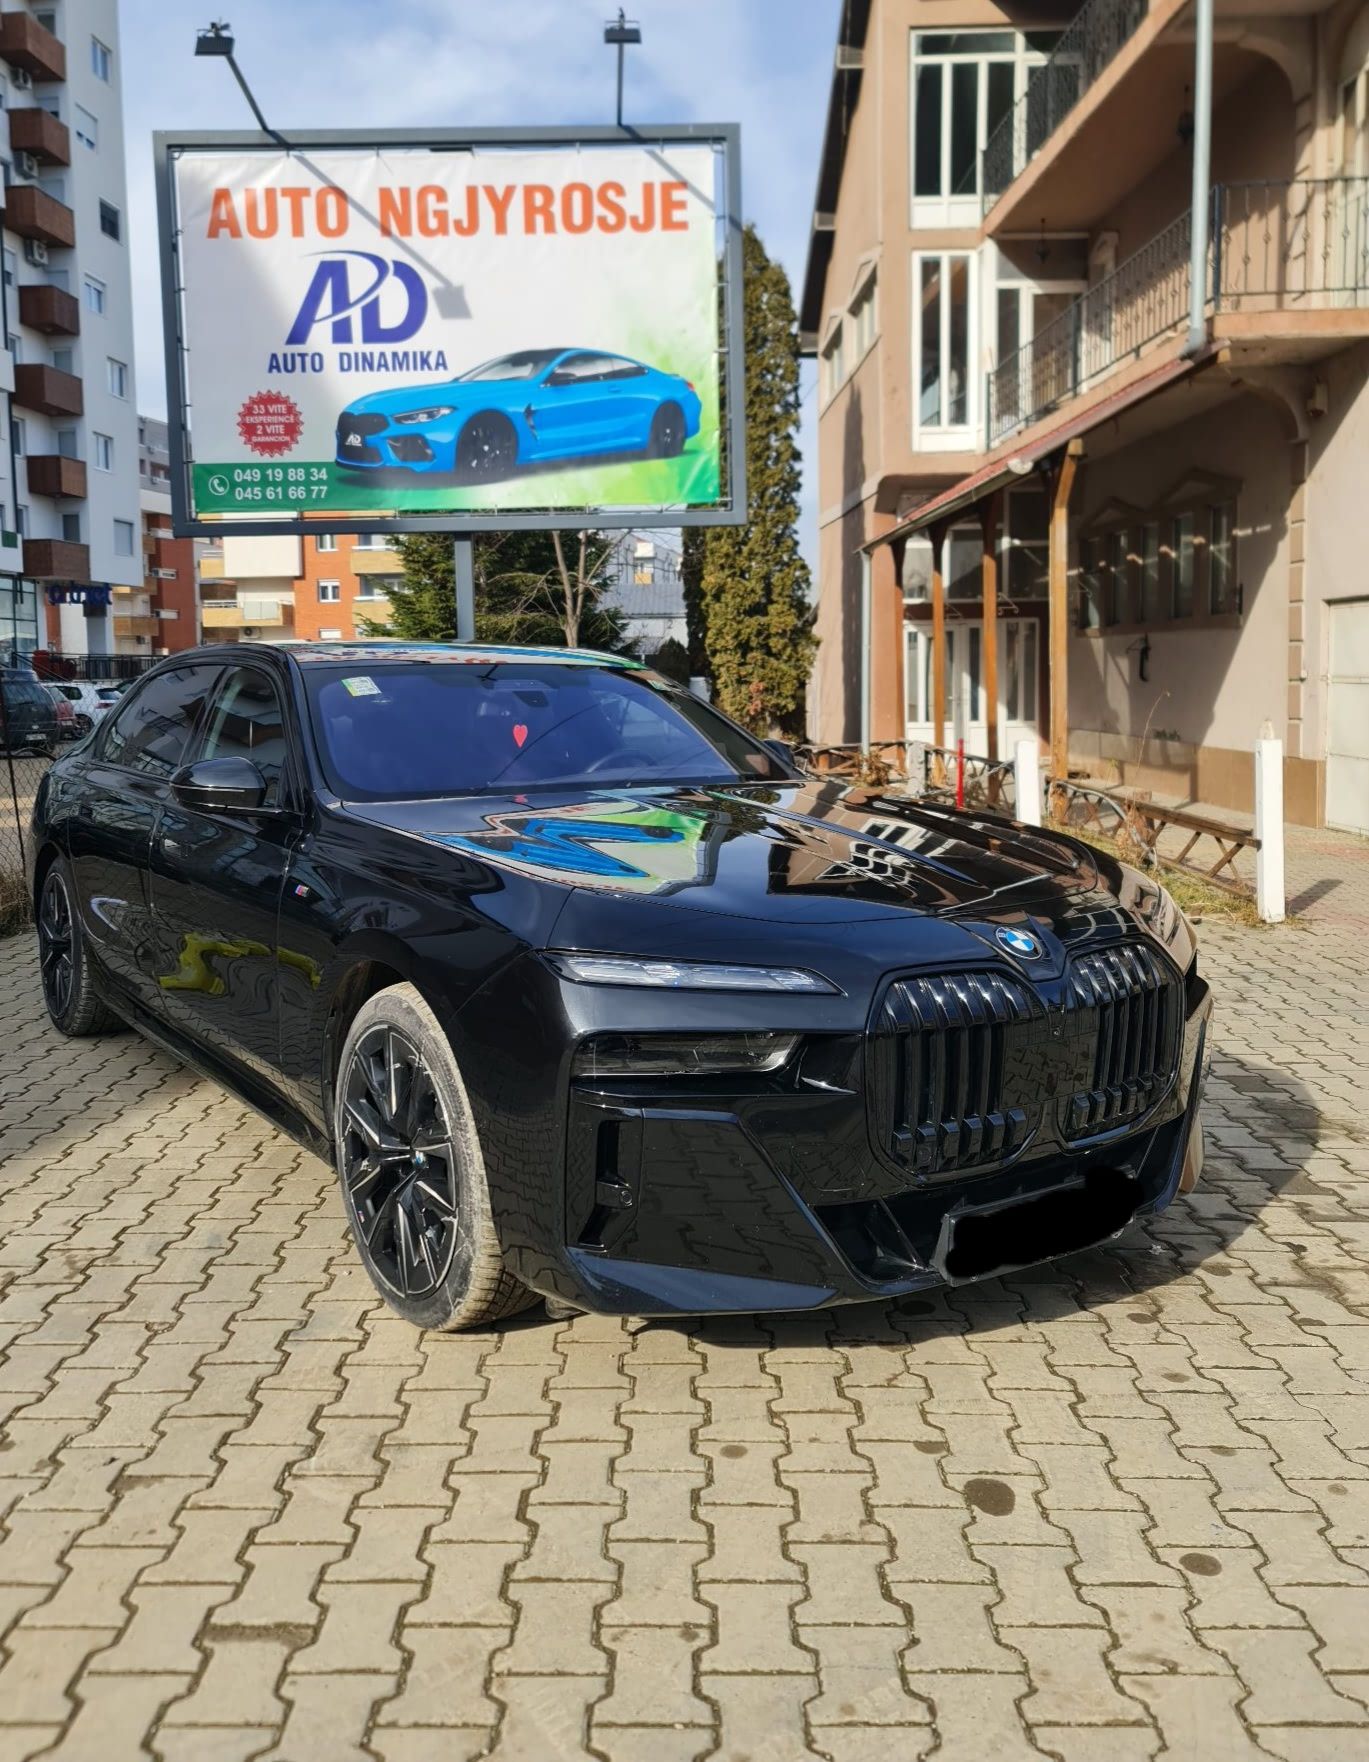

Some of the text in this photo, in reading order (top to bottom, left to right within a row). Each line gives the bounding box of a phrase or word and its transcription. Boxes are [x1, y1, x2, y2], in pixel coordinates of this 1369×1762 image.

[206, 181, 689, 240] AUTO NGJYROSJE
[266, 350, 449, 375] AUTO DINAMIKA
[252, 404, 287, 414] 33 VITE
[256, 424, 285, 434] 2 VITE
[234, 467, 328, 482] 049 19 88 34
[235, 485, 328, 500] 045 61 66 77
